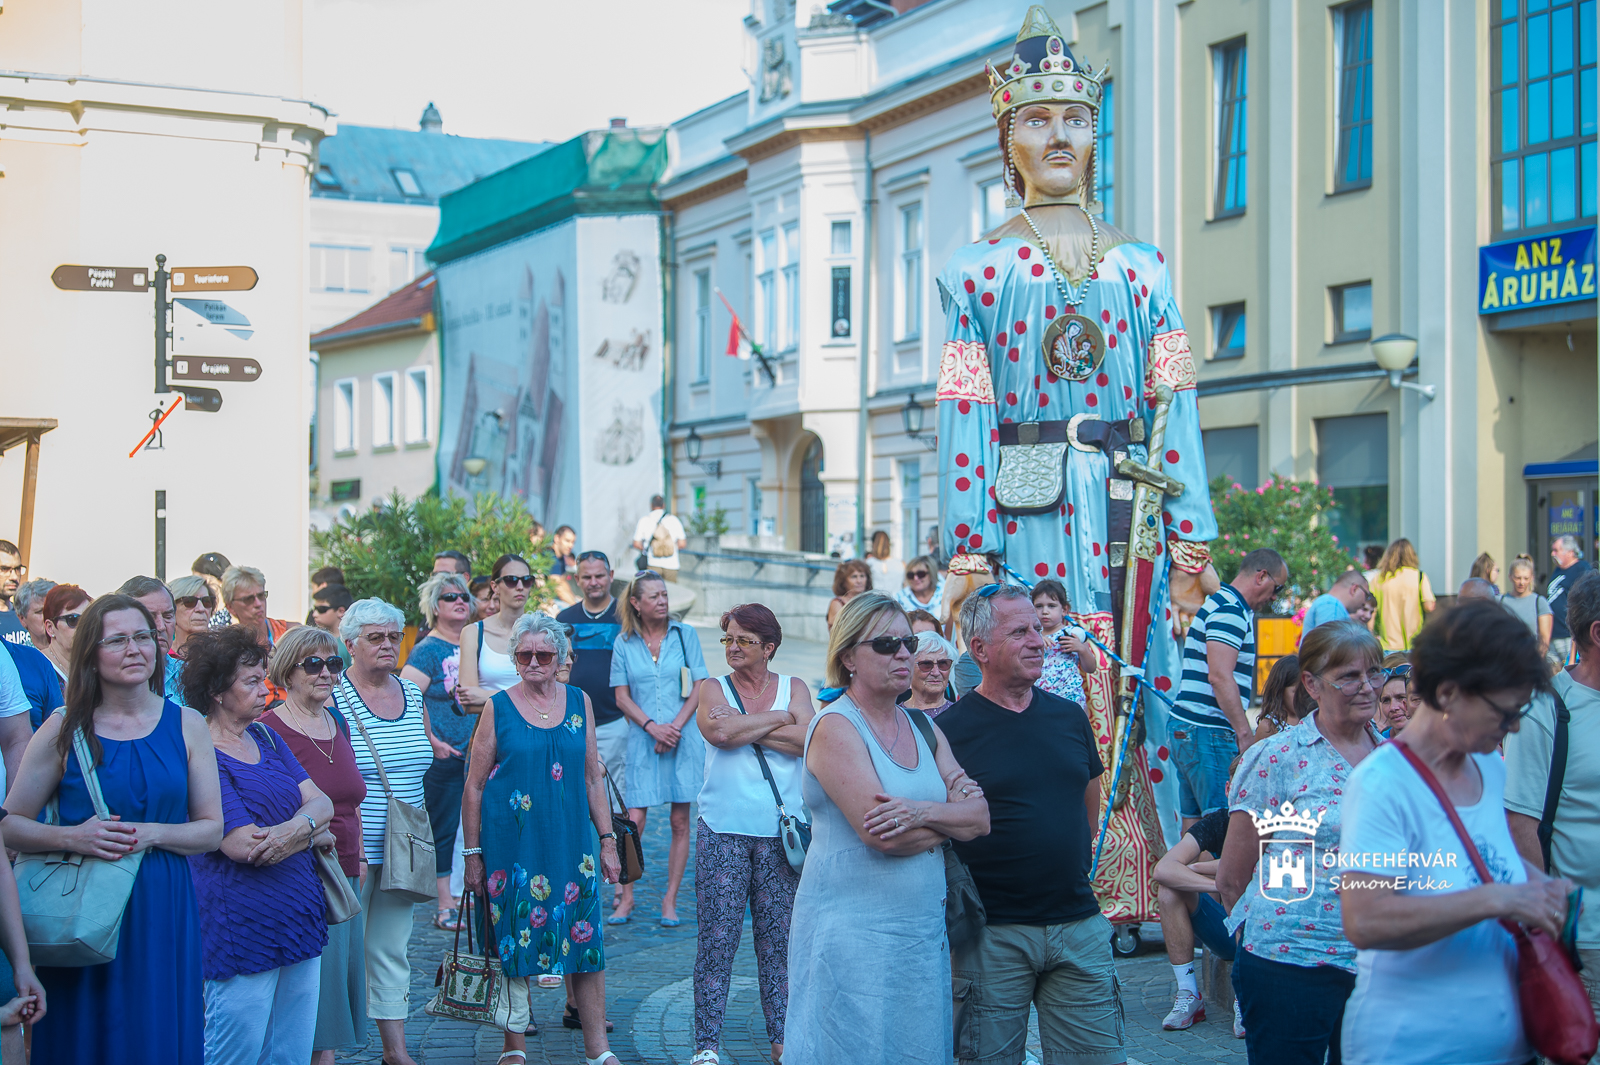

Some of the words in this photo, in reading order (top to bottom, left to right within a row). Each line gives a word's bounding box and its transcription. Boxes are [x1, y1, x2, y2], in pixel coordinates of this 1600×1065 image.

[1514, 237, 1563, 271] ANZ
[90, 278, 114, 288] Palota
[194, 274, 229, 285] Tourinform
[1482, 258, 1595, 309] ÁRUHÁZ
